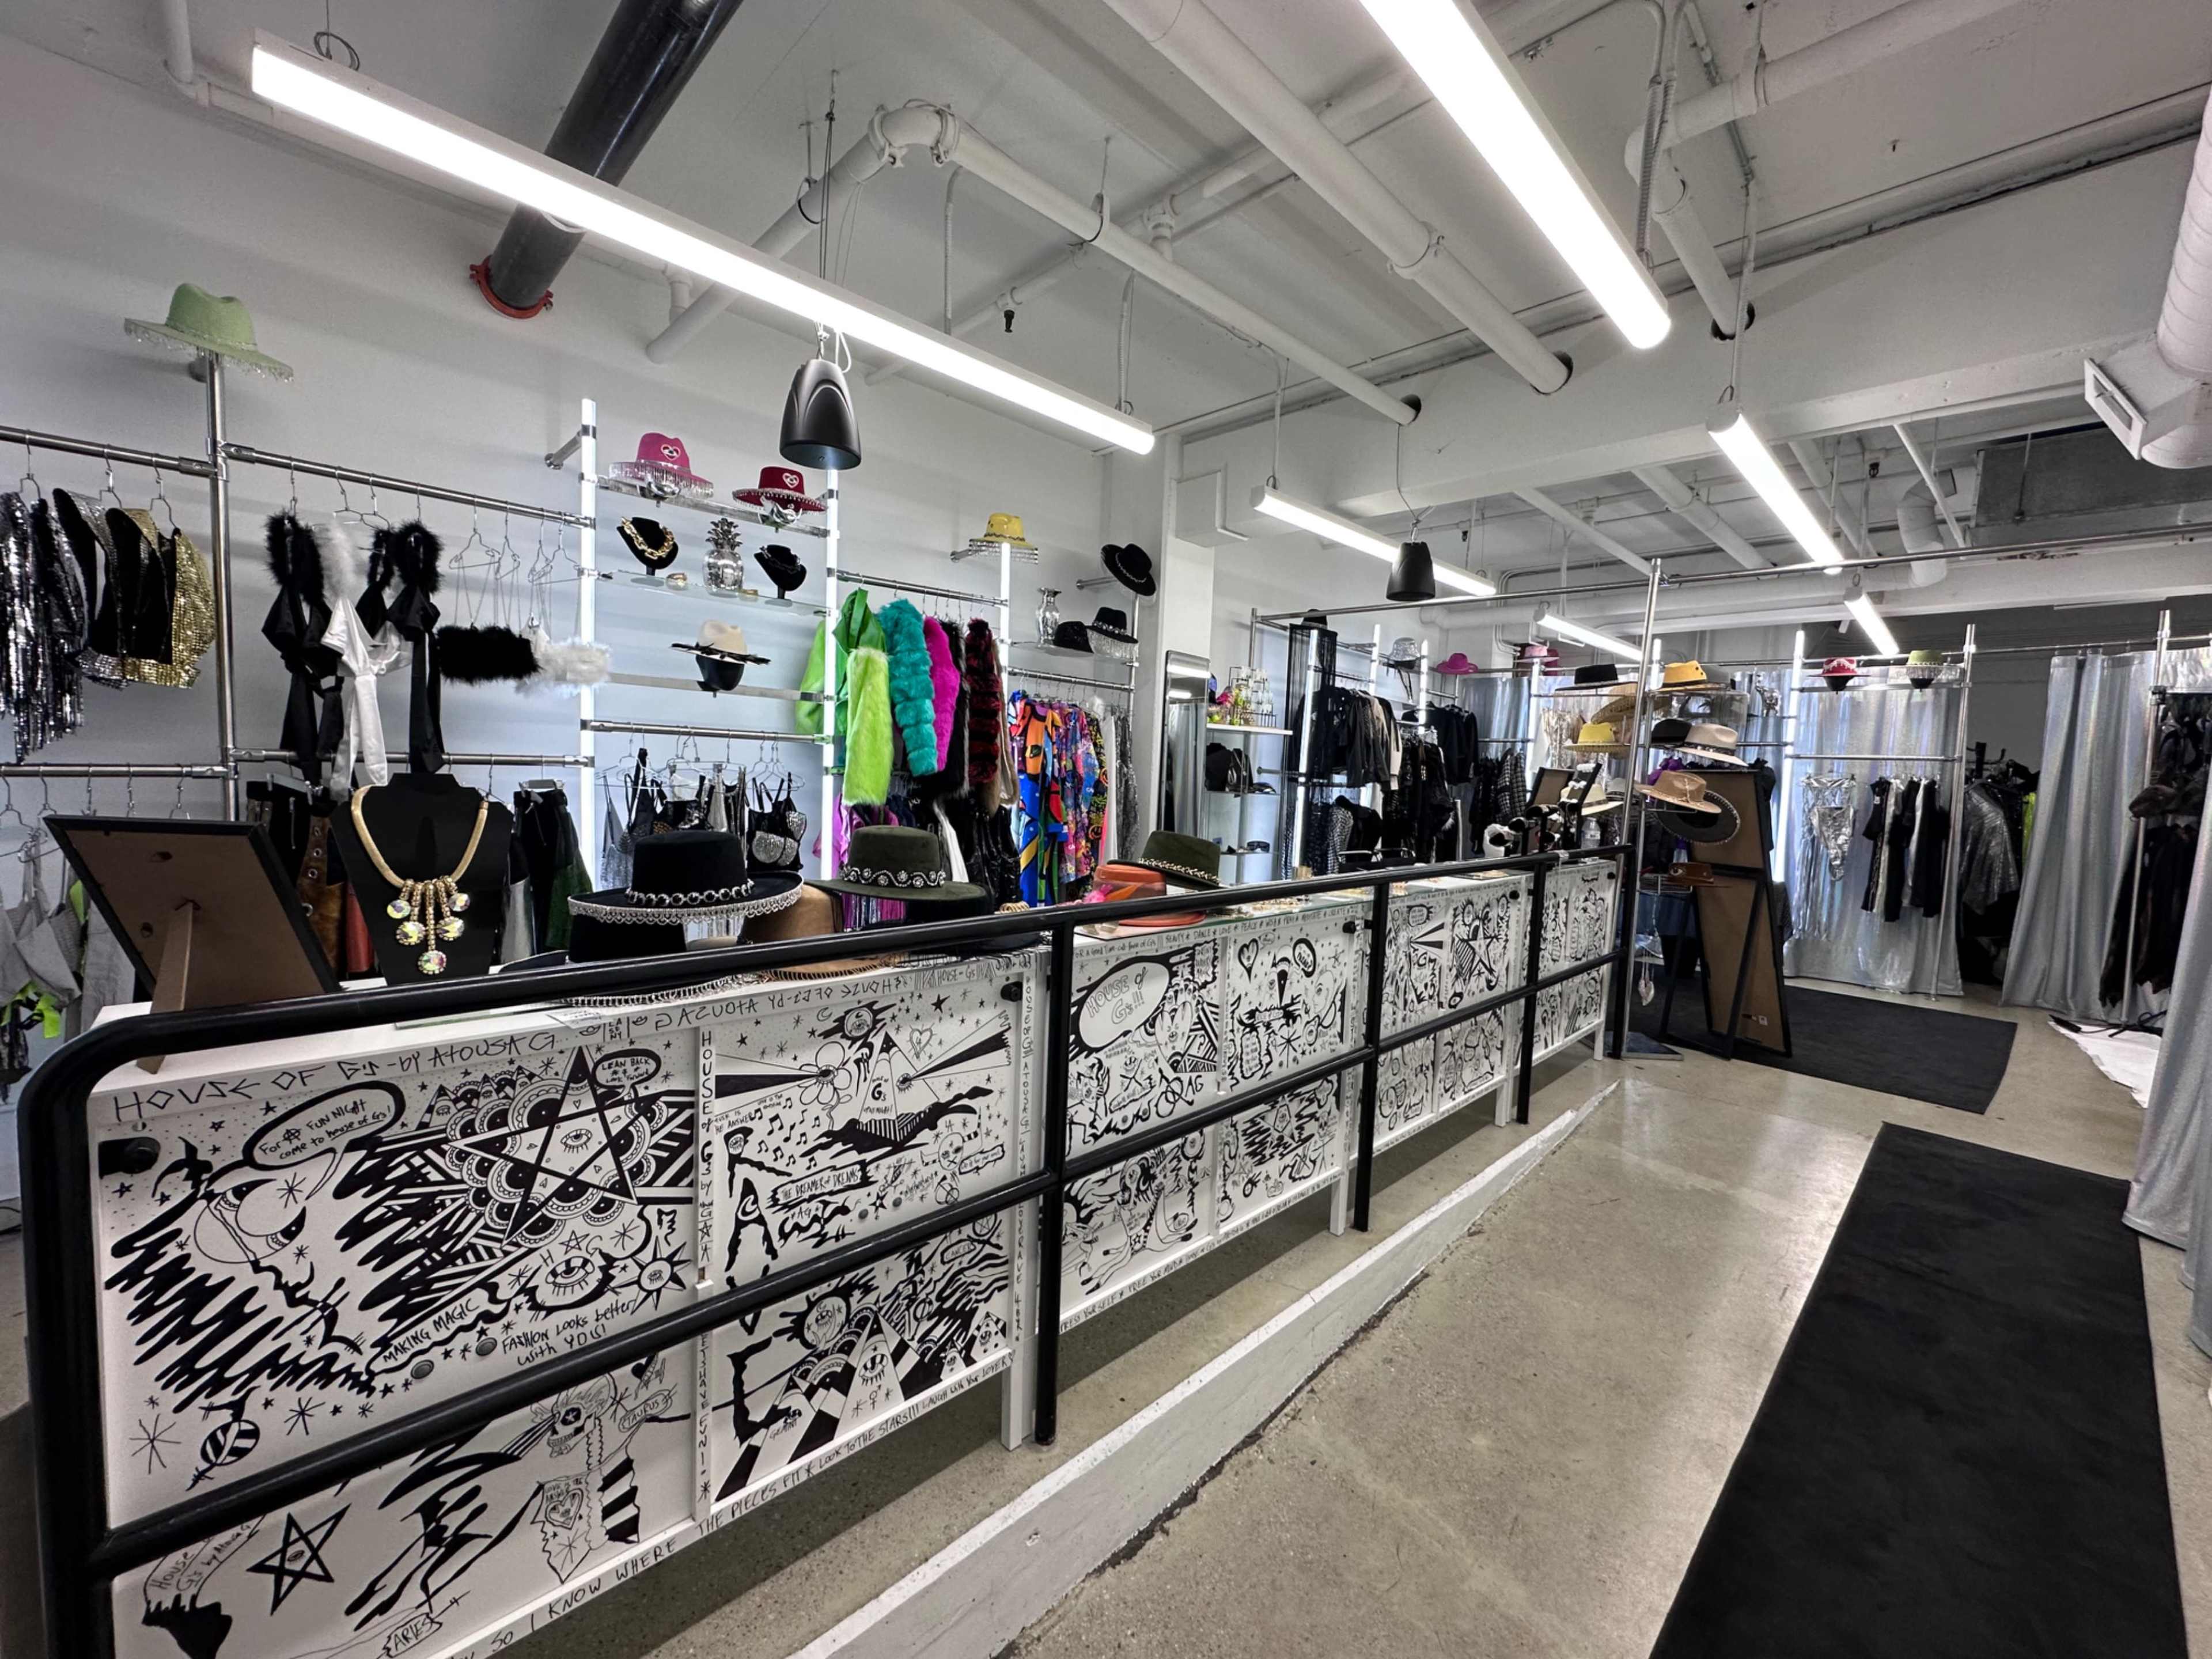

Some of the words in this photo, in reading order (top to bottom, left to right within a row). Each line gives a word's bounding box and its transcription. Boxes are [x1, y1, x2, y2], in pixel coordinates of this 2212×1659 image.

[1086, 975, 1130, 1018] HOUSE
[1134, 966, 1148, 990] of
[601, 1059, 626, 1070] LEAN
[630, 1058, 651, 1066] BACK
[701, 1031, 714, 1115] HOUSE
[306, 1115, 331, 1130] FUN
[326, 1120, 354, 1138] house
[795, 1176, 826, 1196] DREAMER
[832, 1166, 859, 1187] DREAMS
[383, 1330, 431, 1362] MAKING
[433, 1300, 480, 1333] MAGIC
[502, 1328, 549, 1354] FASHION
[624, 1399, 661, 1425] TAURUS
[491, 1631, 513, 1653] SO
[548, 1578, 602, 1619] KNOW
[616, 1537, 678, 1581] WHERE
[695, 1514, 724, 1536] THE
[819, 1445, 842, 1469] LOOK
[854, 1430, 875, 1450] THE
[392, 1615, 433, 1650] ARIES
